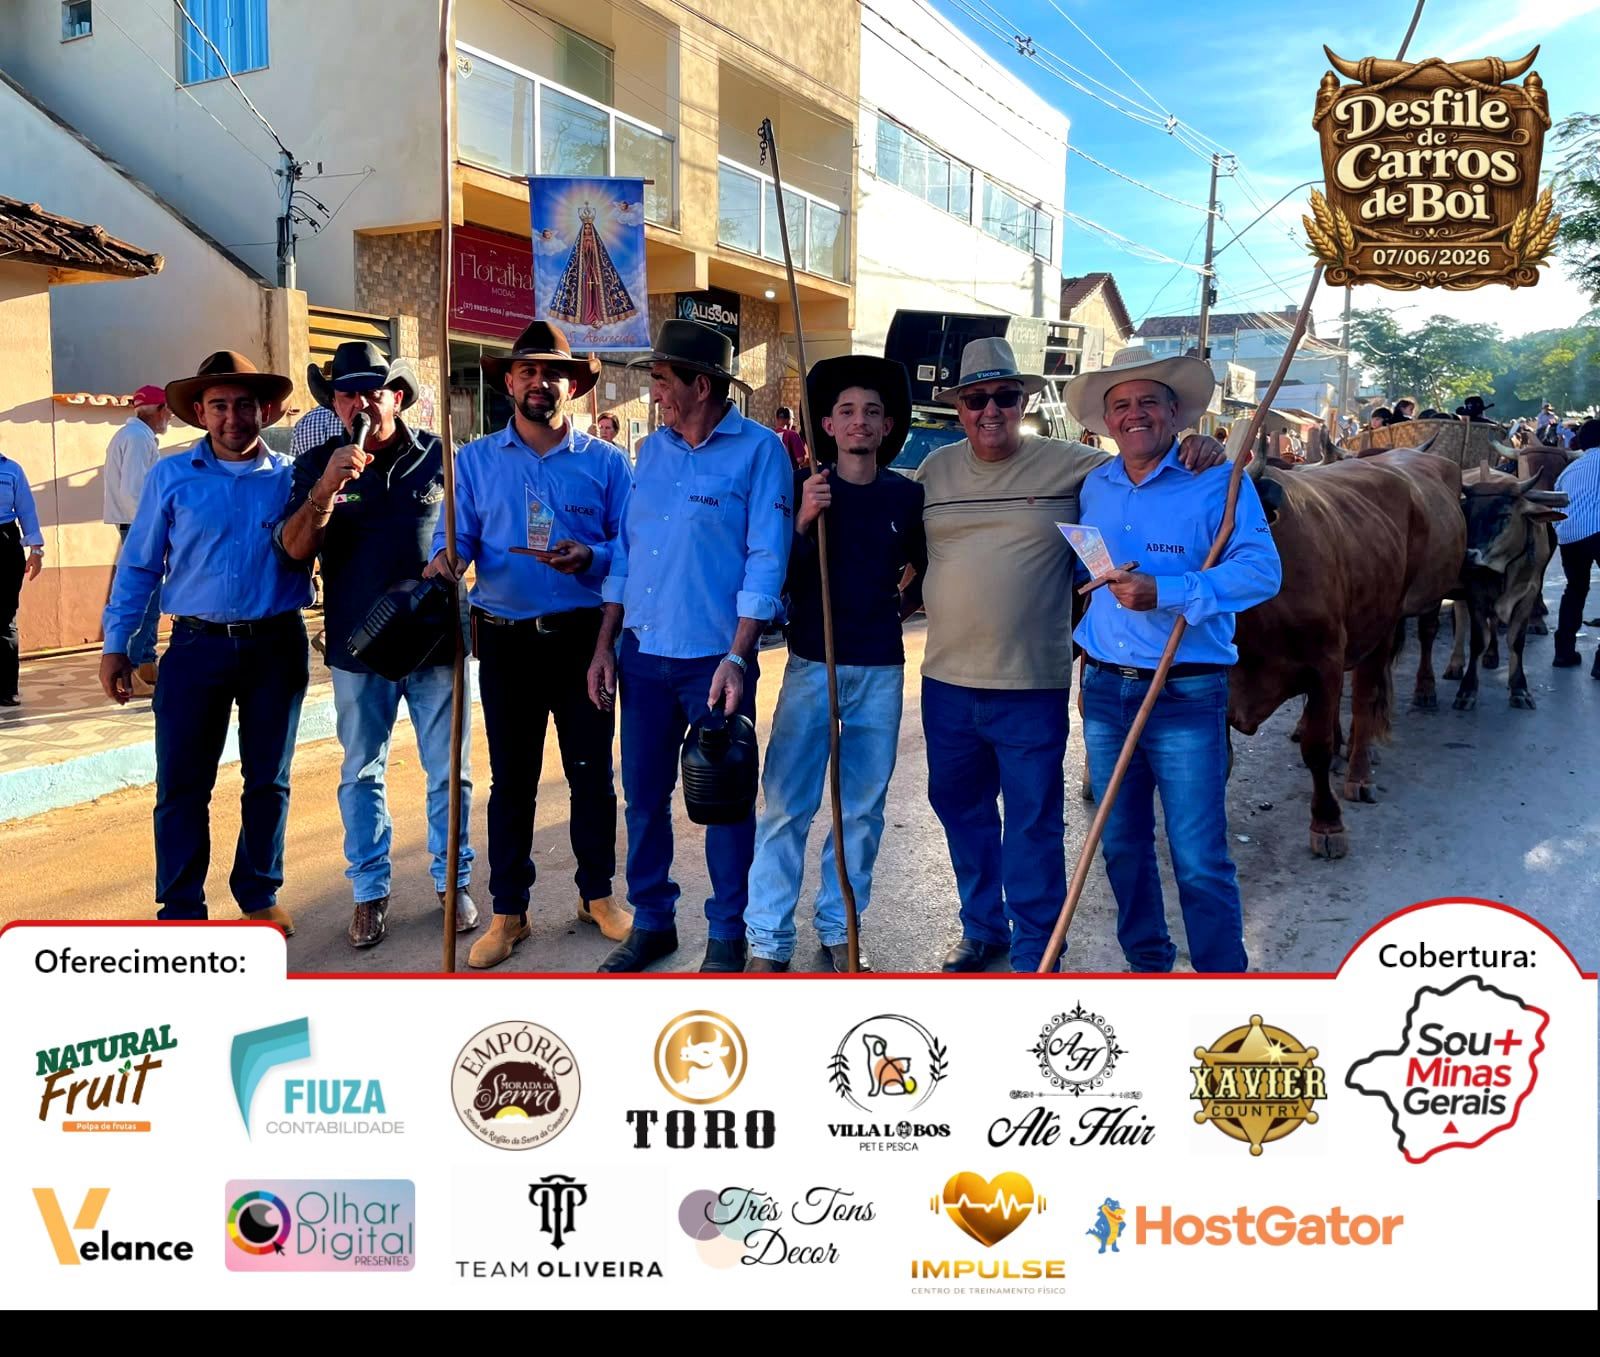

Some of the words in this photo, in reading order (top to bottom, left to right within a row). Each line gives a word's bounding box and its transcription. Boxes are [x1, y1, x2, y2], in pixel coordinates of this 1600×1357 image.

[491, 287, 516, 298] MODAS
[564, 504, 594, 516] LUCAS
[1145, 543, 1185, 555] ADEMIR
